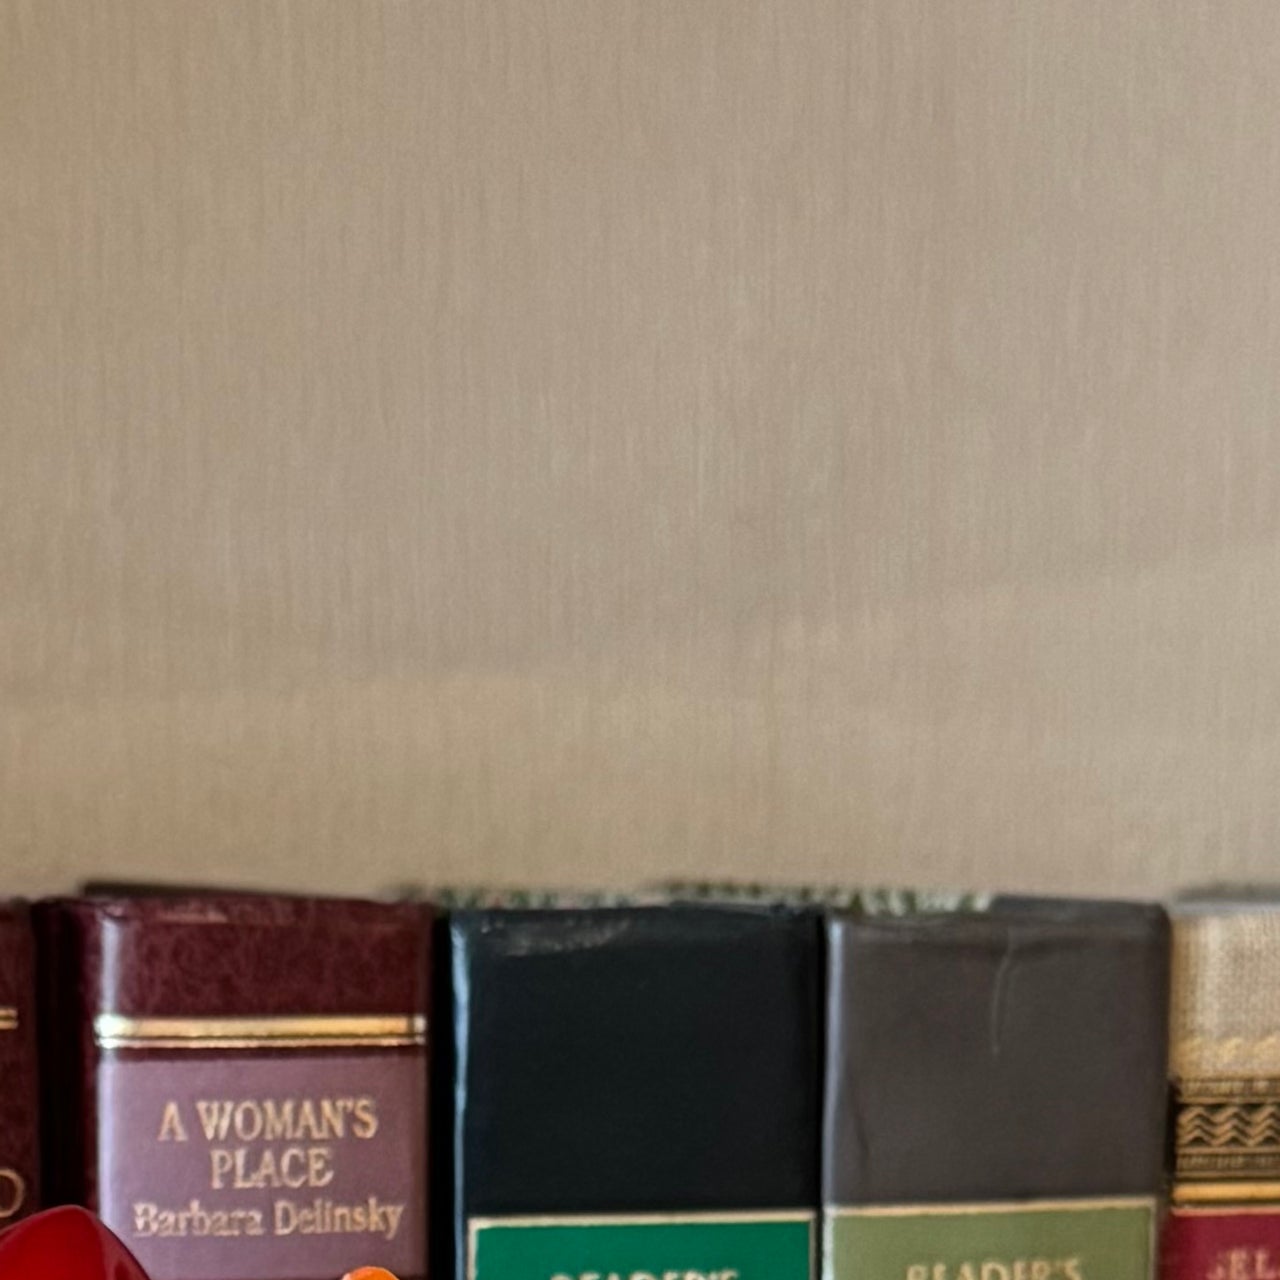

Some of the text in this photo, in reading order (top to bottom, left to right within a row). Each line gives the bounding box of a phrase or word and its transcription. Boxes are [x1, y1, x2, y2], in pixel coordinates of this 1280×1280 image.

[158, 1098, 378, 1142] A WOMAN'S
[210, 1147, 333, 1189] PLACE
[133, 1199, 405, 1241] Barbara Delinsky
